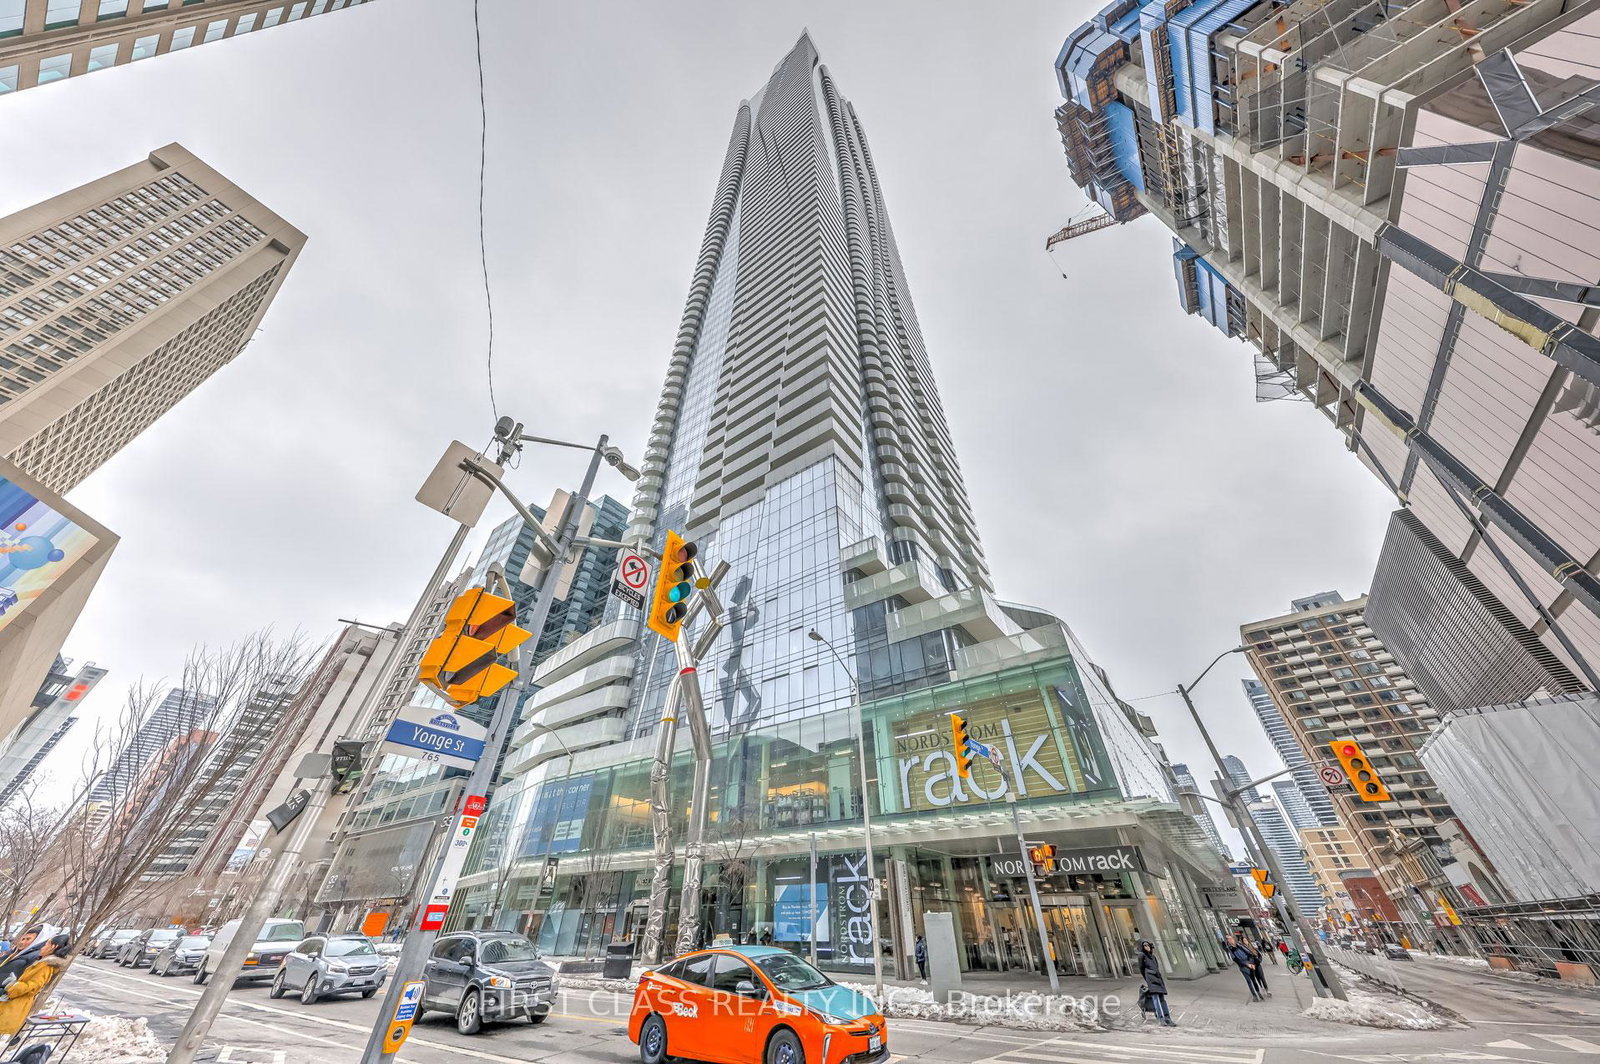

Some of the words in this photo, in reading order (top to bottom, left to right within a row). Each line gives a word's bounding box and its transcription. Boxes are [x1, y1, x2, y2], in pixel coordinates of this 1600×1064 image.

[614, 589, 640, 608] EXCEPTED
[617, 582, 641, 601] BICYCLES
[412, 726, 453, 751] Yonge
[454, 740, 466, 753] St
[898, 723, 998, 753] NORDSOM
[421, 751, 440, 762] 765
[898, 718, 1066, 809] rack
[1087, 850, 1134, 871] rack
[836, 854, 876, 965] rack
[838, 885, 850, 963] NORDSTROM
[673, 1002, 699, 1018] Beck
